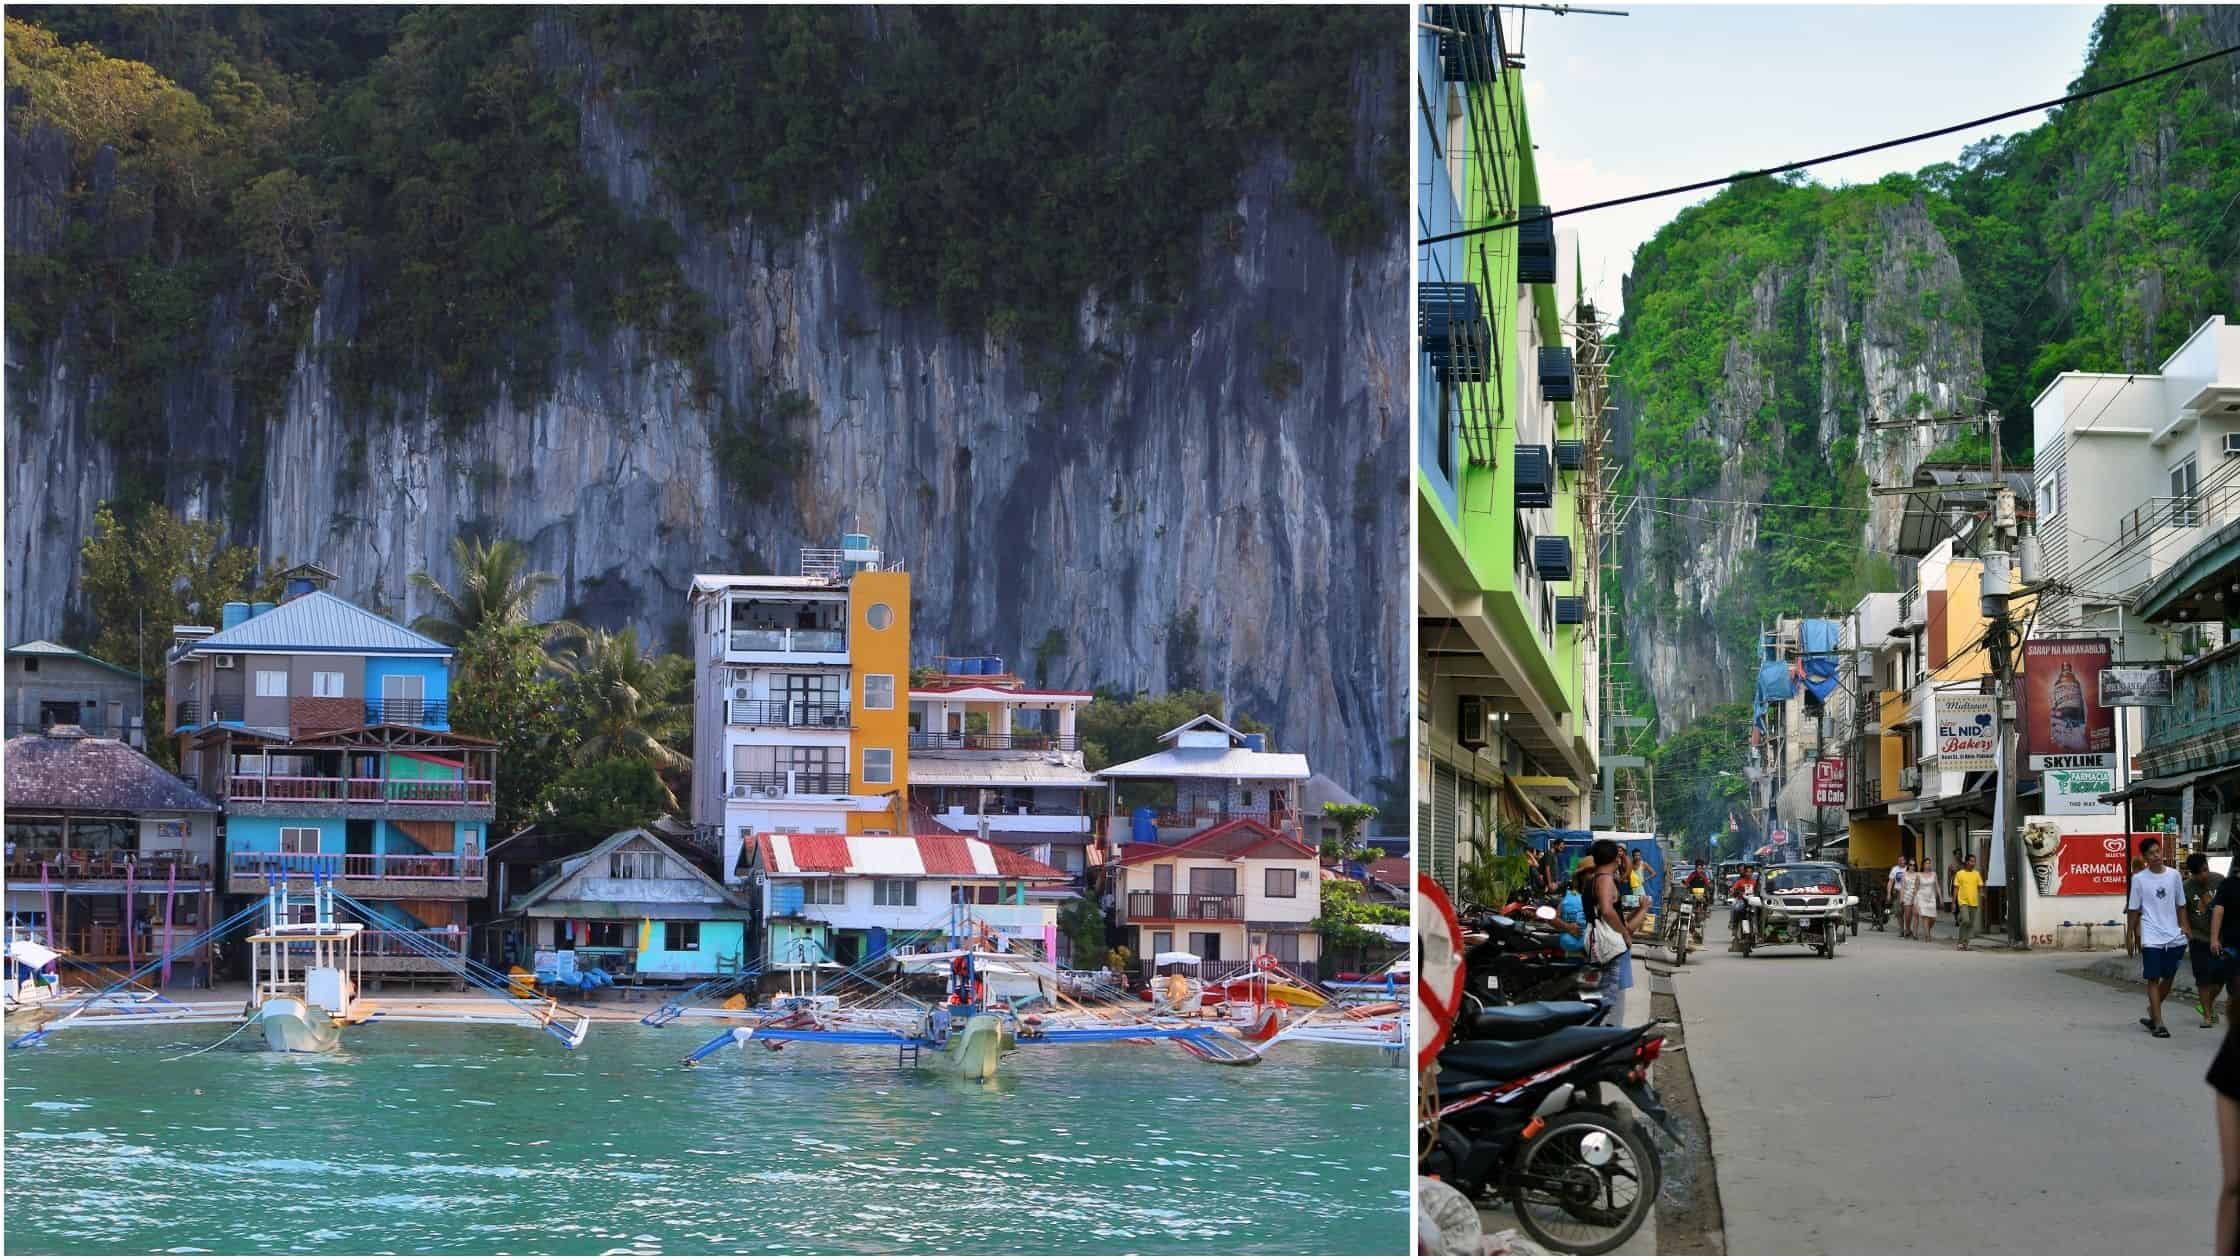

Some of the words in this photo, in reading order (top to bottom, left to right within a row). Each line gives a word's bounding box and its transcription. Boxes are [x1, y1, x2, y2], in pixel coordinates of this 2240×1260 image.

[2051, 645, 2061, 655] NA
[1940, 726, 1957, 737] EL
[1942, 736, 1993, 753] Bakery
[2043, 754, 2104, 769] SKYLINE
[2071, 863, 2123, 874] FARMACIA
[2102, 875, 2121, 883] CREAM
